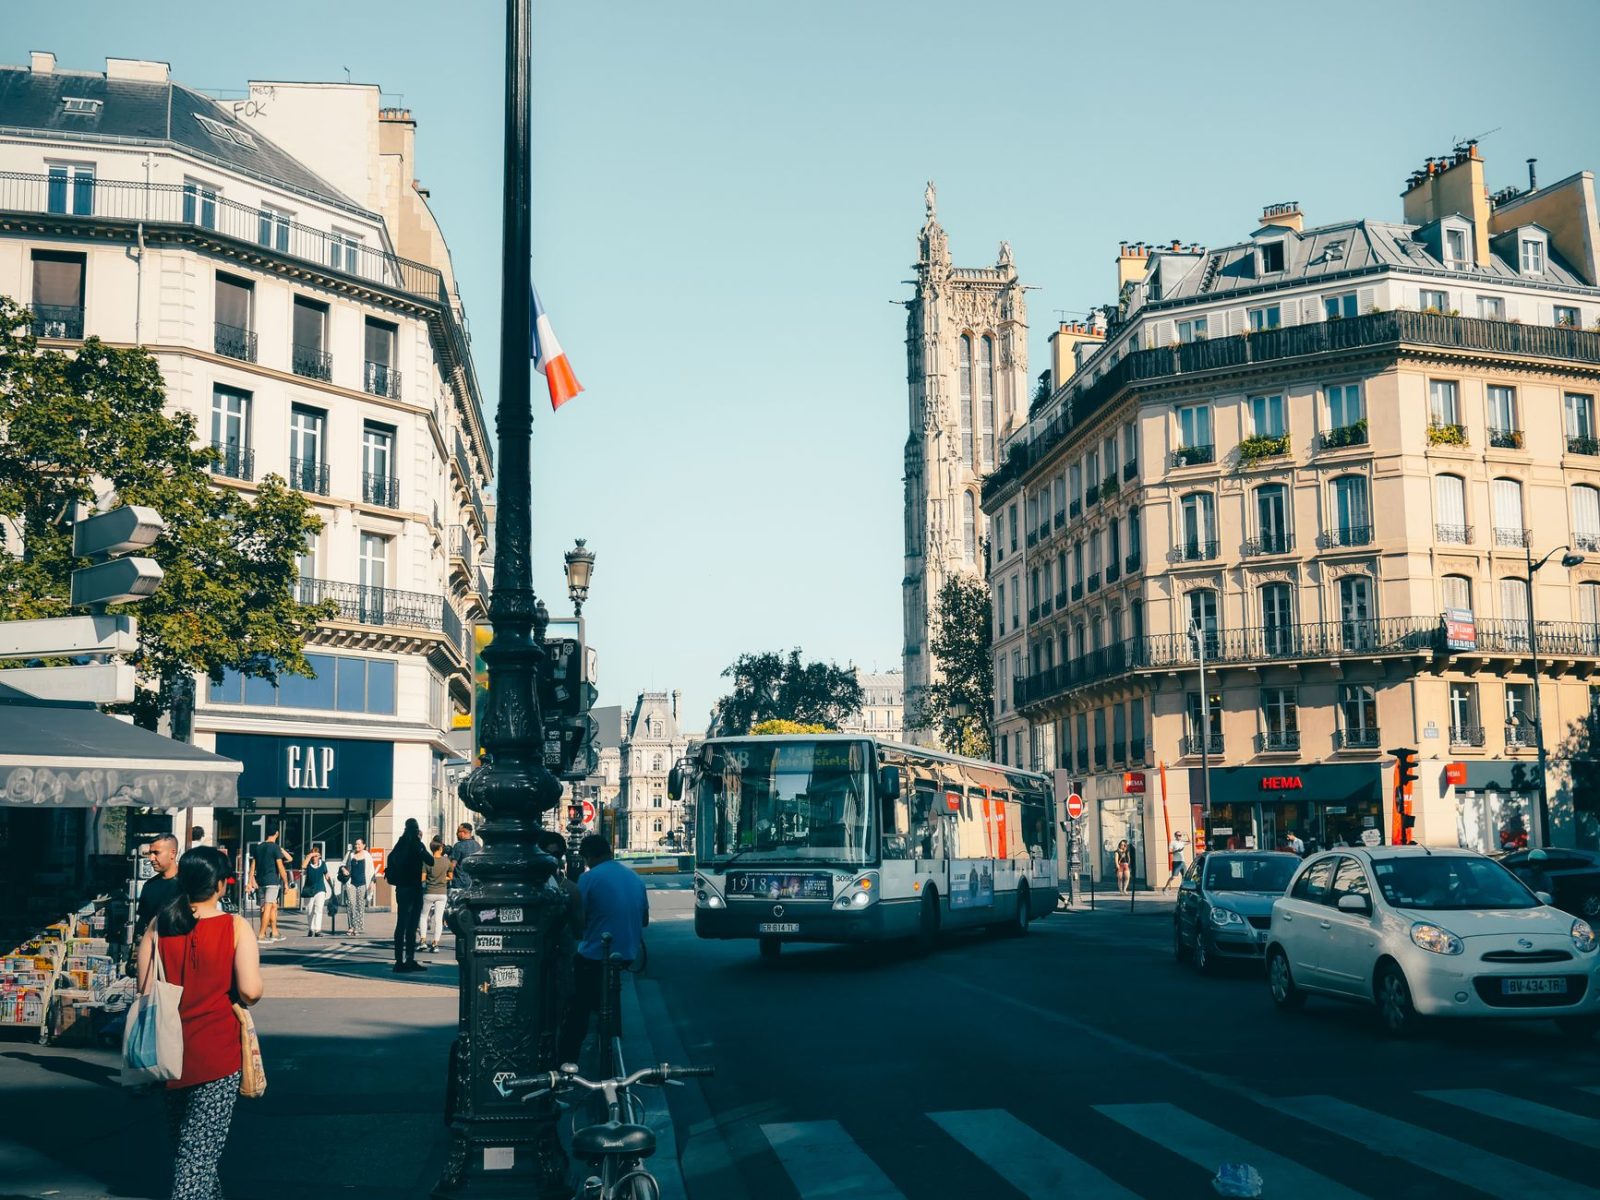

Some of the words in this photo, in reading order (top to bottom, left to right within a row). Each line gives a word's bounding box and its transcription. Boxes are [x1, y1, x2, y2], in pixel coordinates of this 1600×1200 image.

[287, 745, 334, 789] GAP
[1263, 776, 1303, 789] HEMA
[732, 877, 767, 890] 1918
